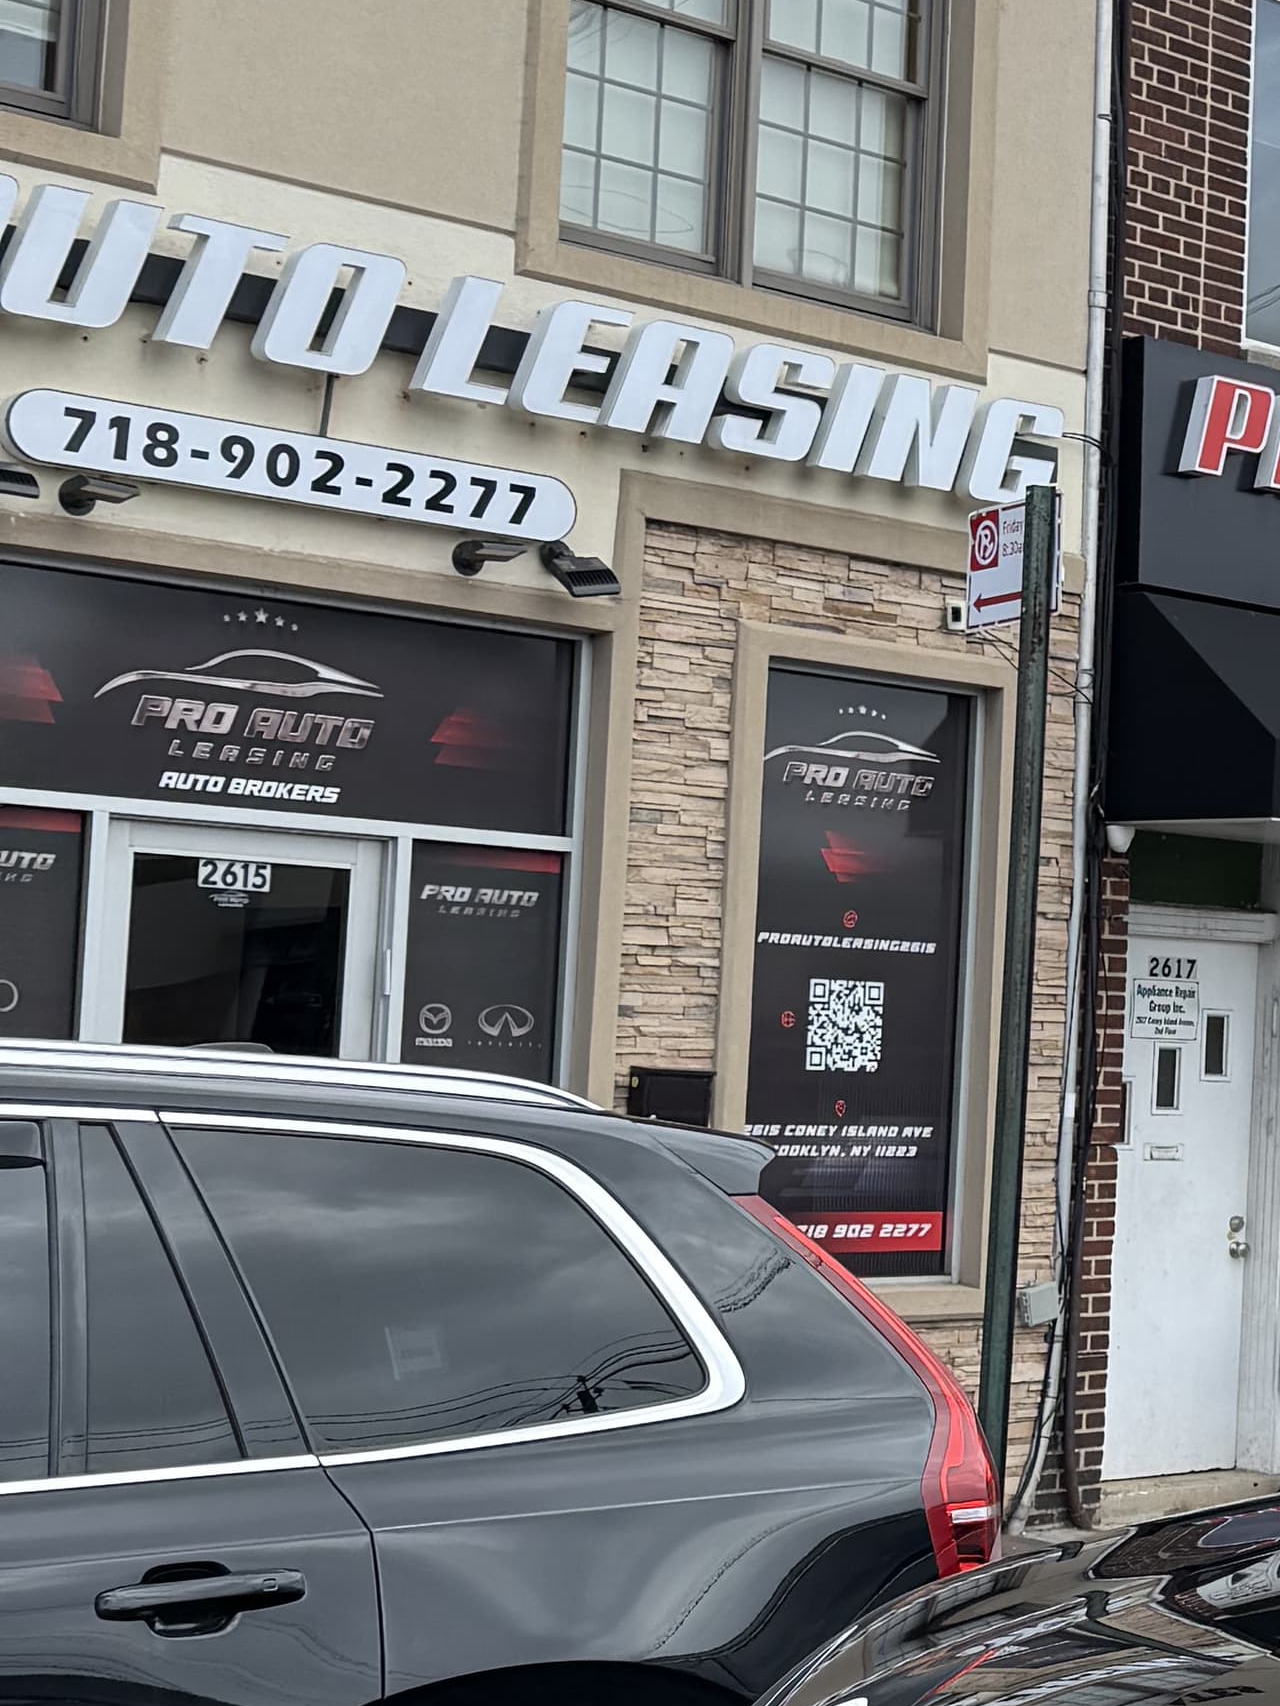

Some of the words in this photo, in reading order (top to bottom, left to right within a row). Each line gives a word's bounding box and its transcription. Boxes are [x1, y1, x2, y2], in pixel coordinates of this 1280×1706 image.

[0, 174, 408, 377] UTO
[410, 275, 1065, 503] LEASING
[63, 407, 537, 525] 718-902-2277
[131, 695, 239, 735] PRO
[244, 707, 375, 749] AUTO
[168, 739, 337, 772] LEASING
[158, 771, 225, 793] AUTO
[227, 777, 341, 804] BROKERS
[783, 761, 849, 787] PRO
[853, 768, 935, 796] AUTO
[805, 790, 911, 811] LEASING
[201, 859, 268, 889] 2615
[420, 884, 473, 902] PRO
[474, 888, 539, 907] AUTO
[757, 931, 937, 954] PROAUTOLEASING2615
[1149, 957, 1197, 979] 2617
[1175, 985, 1196, 1000] Repair
[784, 1124, 836, 1137] CONEY
[841, 1125, 898, 1138] ISLAND
[901, 1126, 933, 1138] AVE
[773, 1144, 846, 1158] OOKLYN,
[850, 1145, 872, 1157] NY
[875, 1145, 918, 1158] 11223
[833, 1224, 875, 1239] 902
[879, 1223, 933, 1238] 2277
